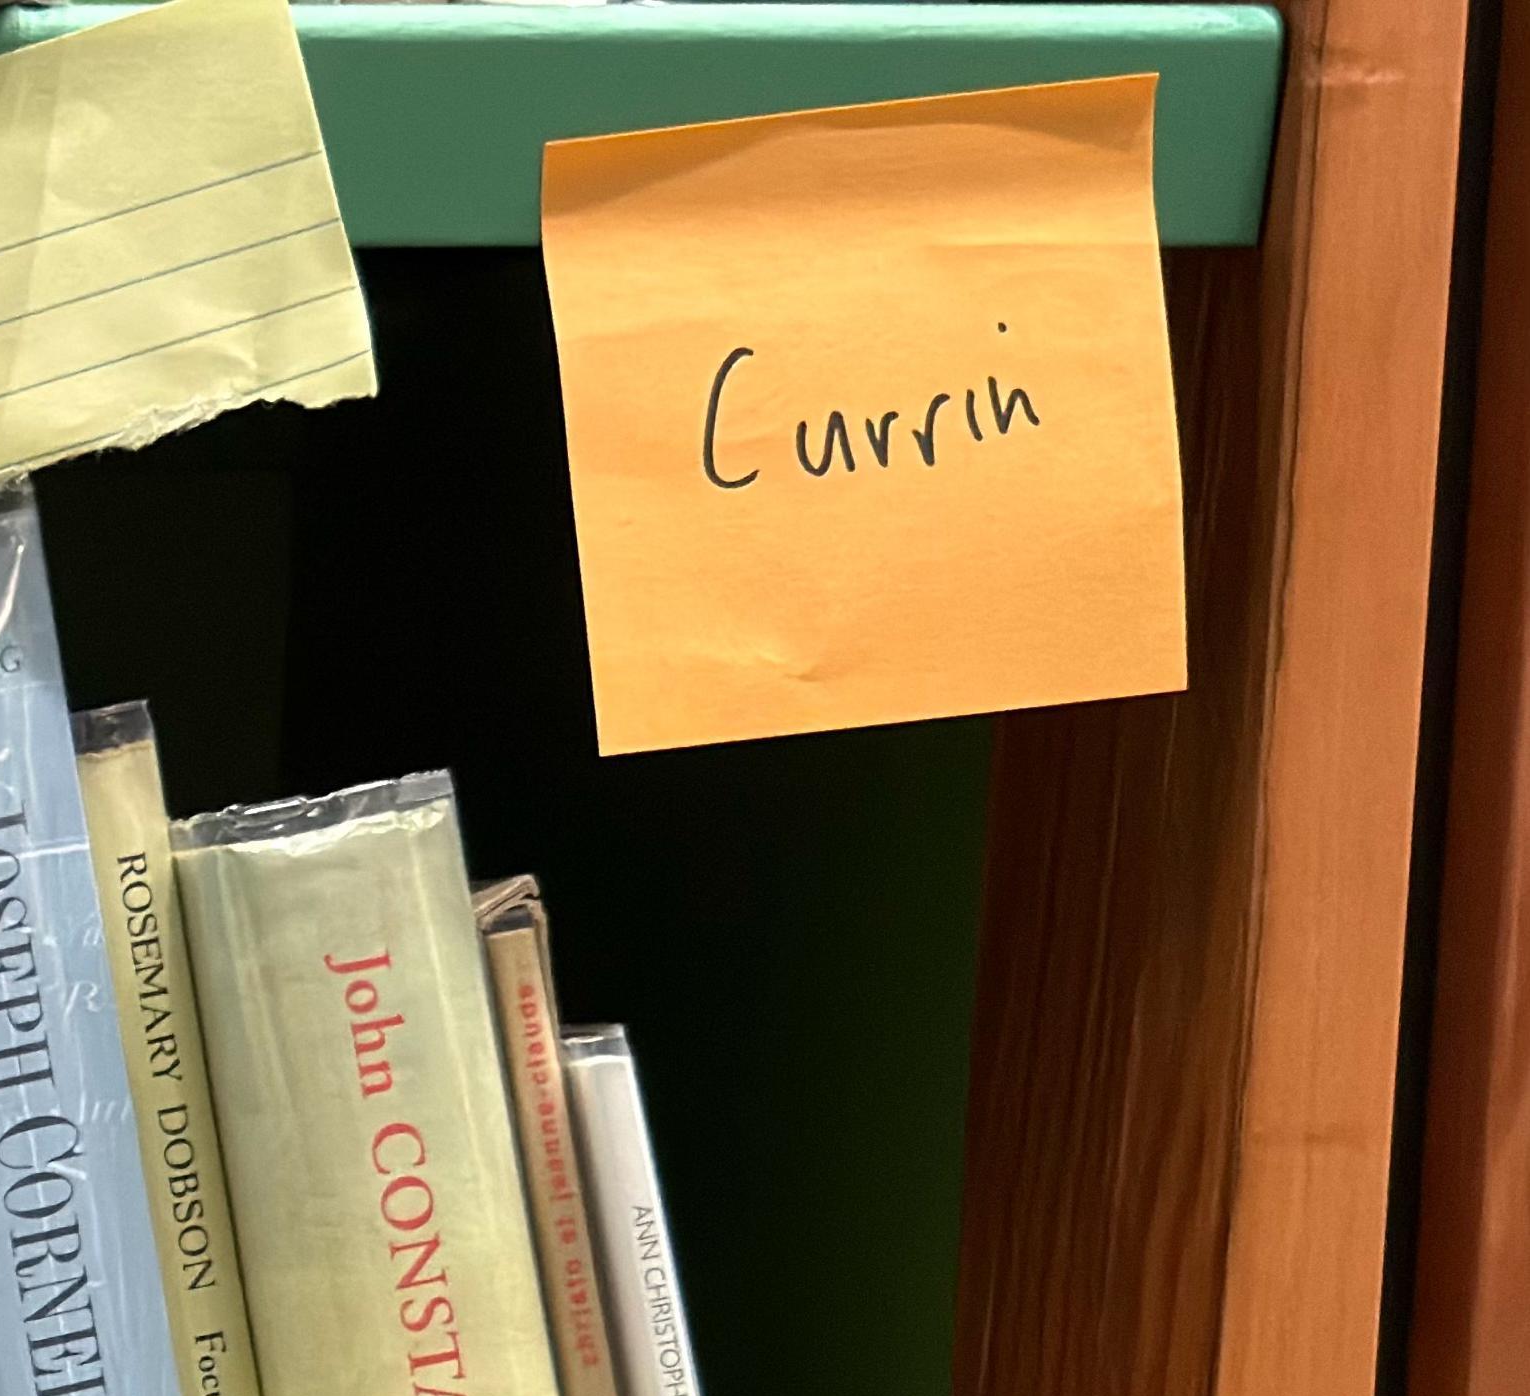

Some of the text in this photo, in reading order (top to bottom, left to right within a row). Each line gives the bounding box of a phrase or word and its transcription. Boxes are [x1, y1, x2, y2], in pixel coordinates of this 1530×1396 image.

[704, 322, 1040, 489] Currin
[116, 851, 183, 1084] ROSEMARY
[157, 1103, 217, 1291] DOBSON
[324, 949, 405, 1100] John
[631, 1205, 661, 1262] ANN
